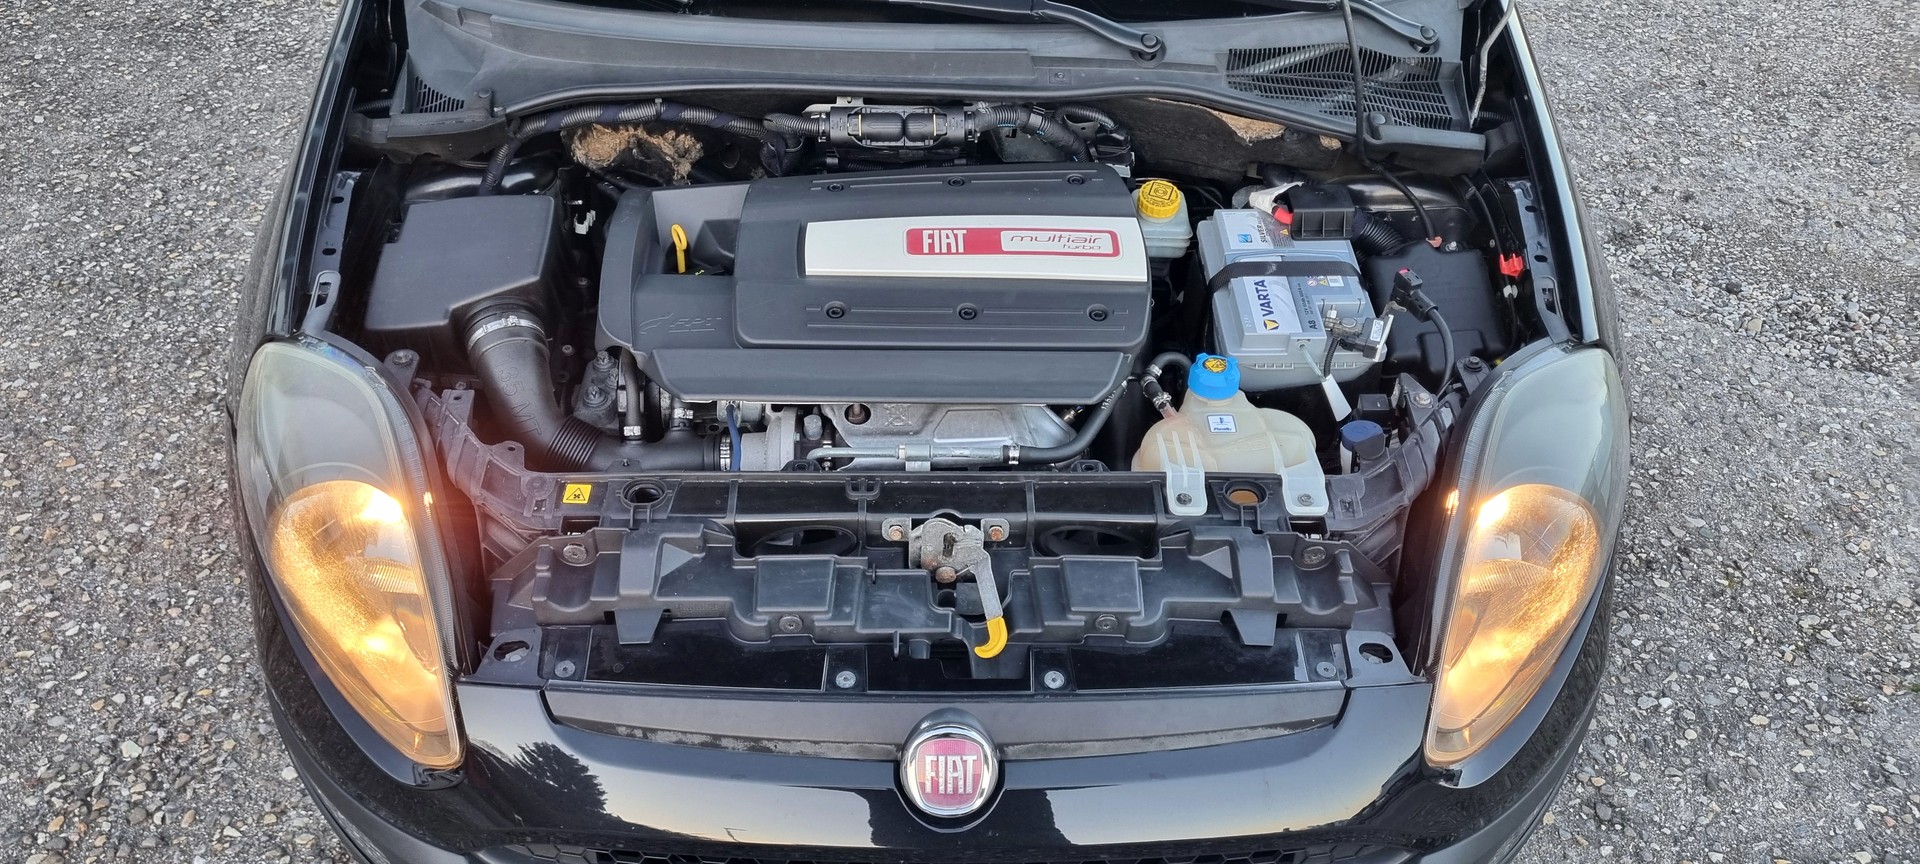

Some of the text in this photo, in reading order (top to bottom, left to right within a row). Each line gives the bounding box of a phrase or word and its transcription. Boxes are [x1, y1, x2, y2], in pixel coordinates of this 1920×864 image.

[922, 229, 968, 254] FIAT
[1010, 233, 1102, 244] multiair
[1254, 279, 1274, 318] VARTA
[1308, 319, 1318, 330] A8
[511, 401, 542, 435] MT
[924, 754, 978, 795] FIAT
